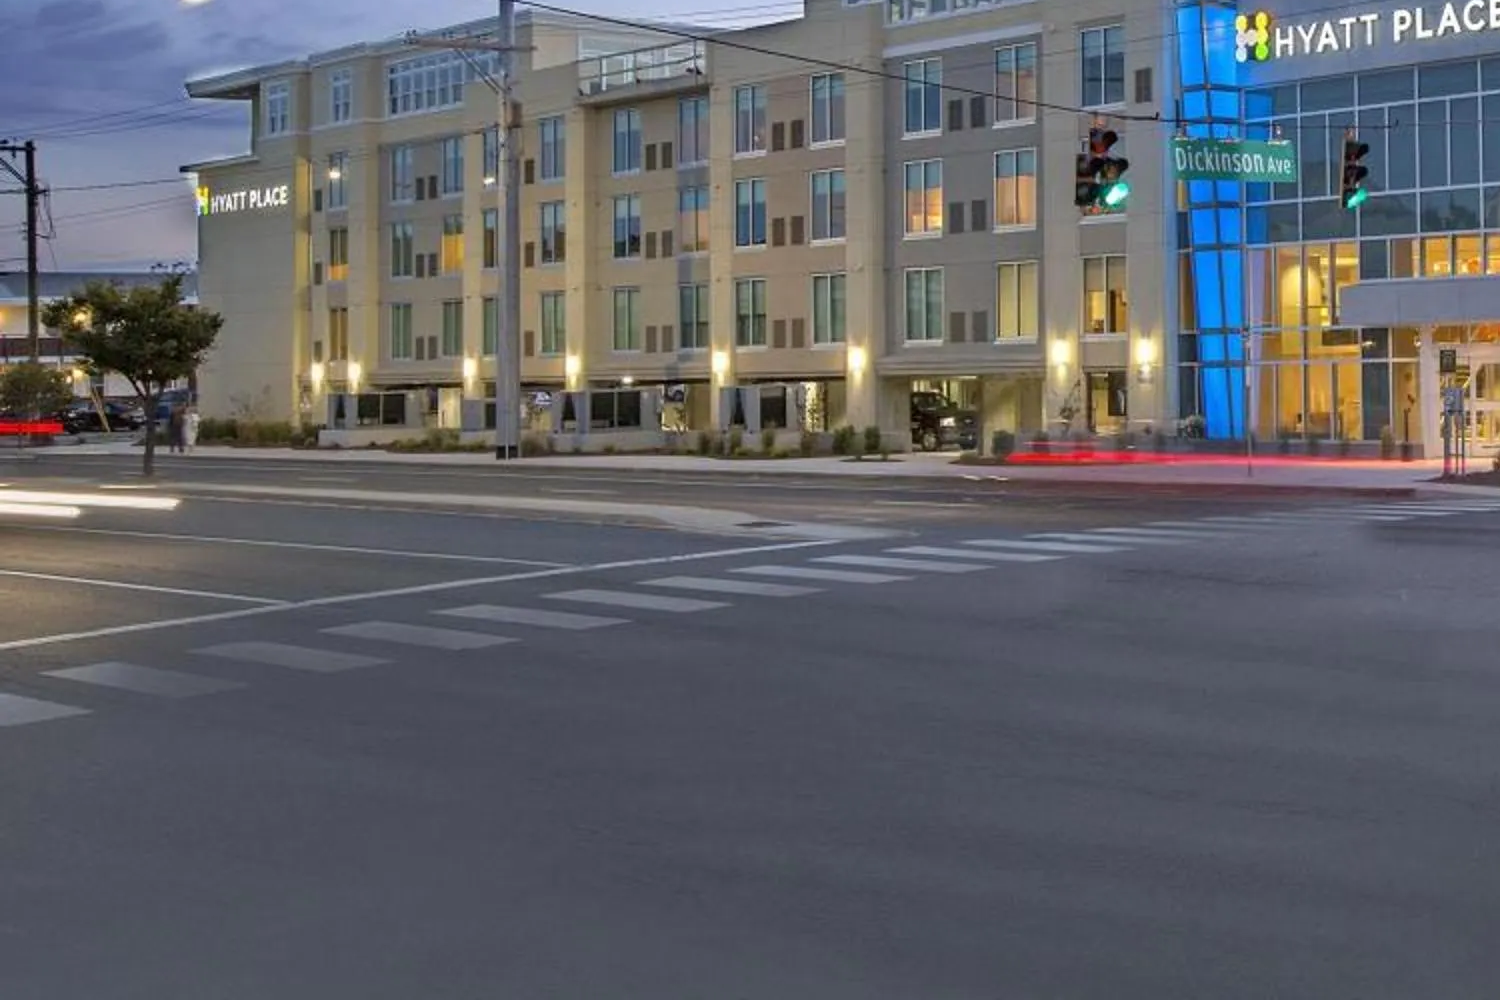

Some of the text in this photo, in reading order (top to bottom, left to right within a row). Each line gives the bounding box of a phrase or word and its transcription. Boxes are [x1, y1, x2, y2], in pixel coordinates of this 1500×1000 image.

[1275, 13, 1379, 58] HYATT
[1175, 145, 1265, 174] Dickinson
[211, 185, 289, 214] HYATT PLACE
